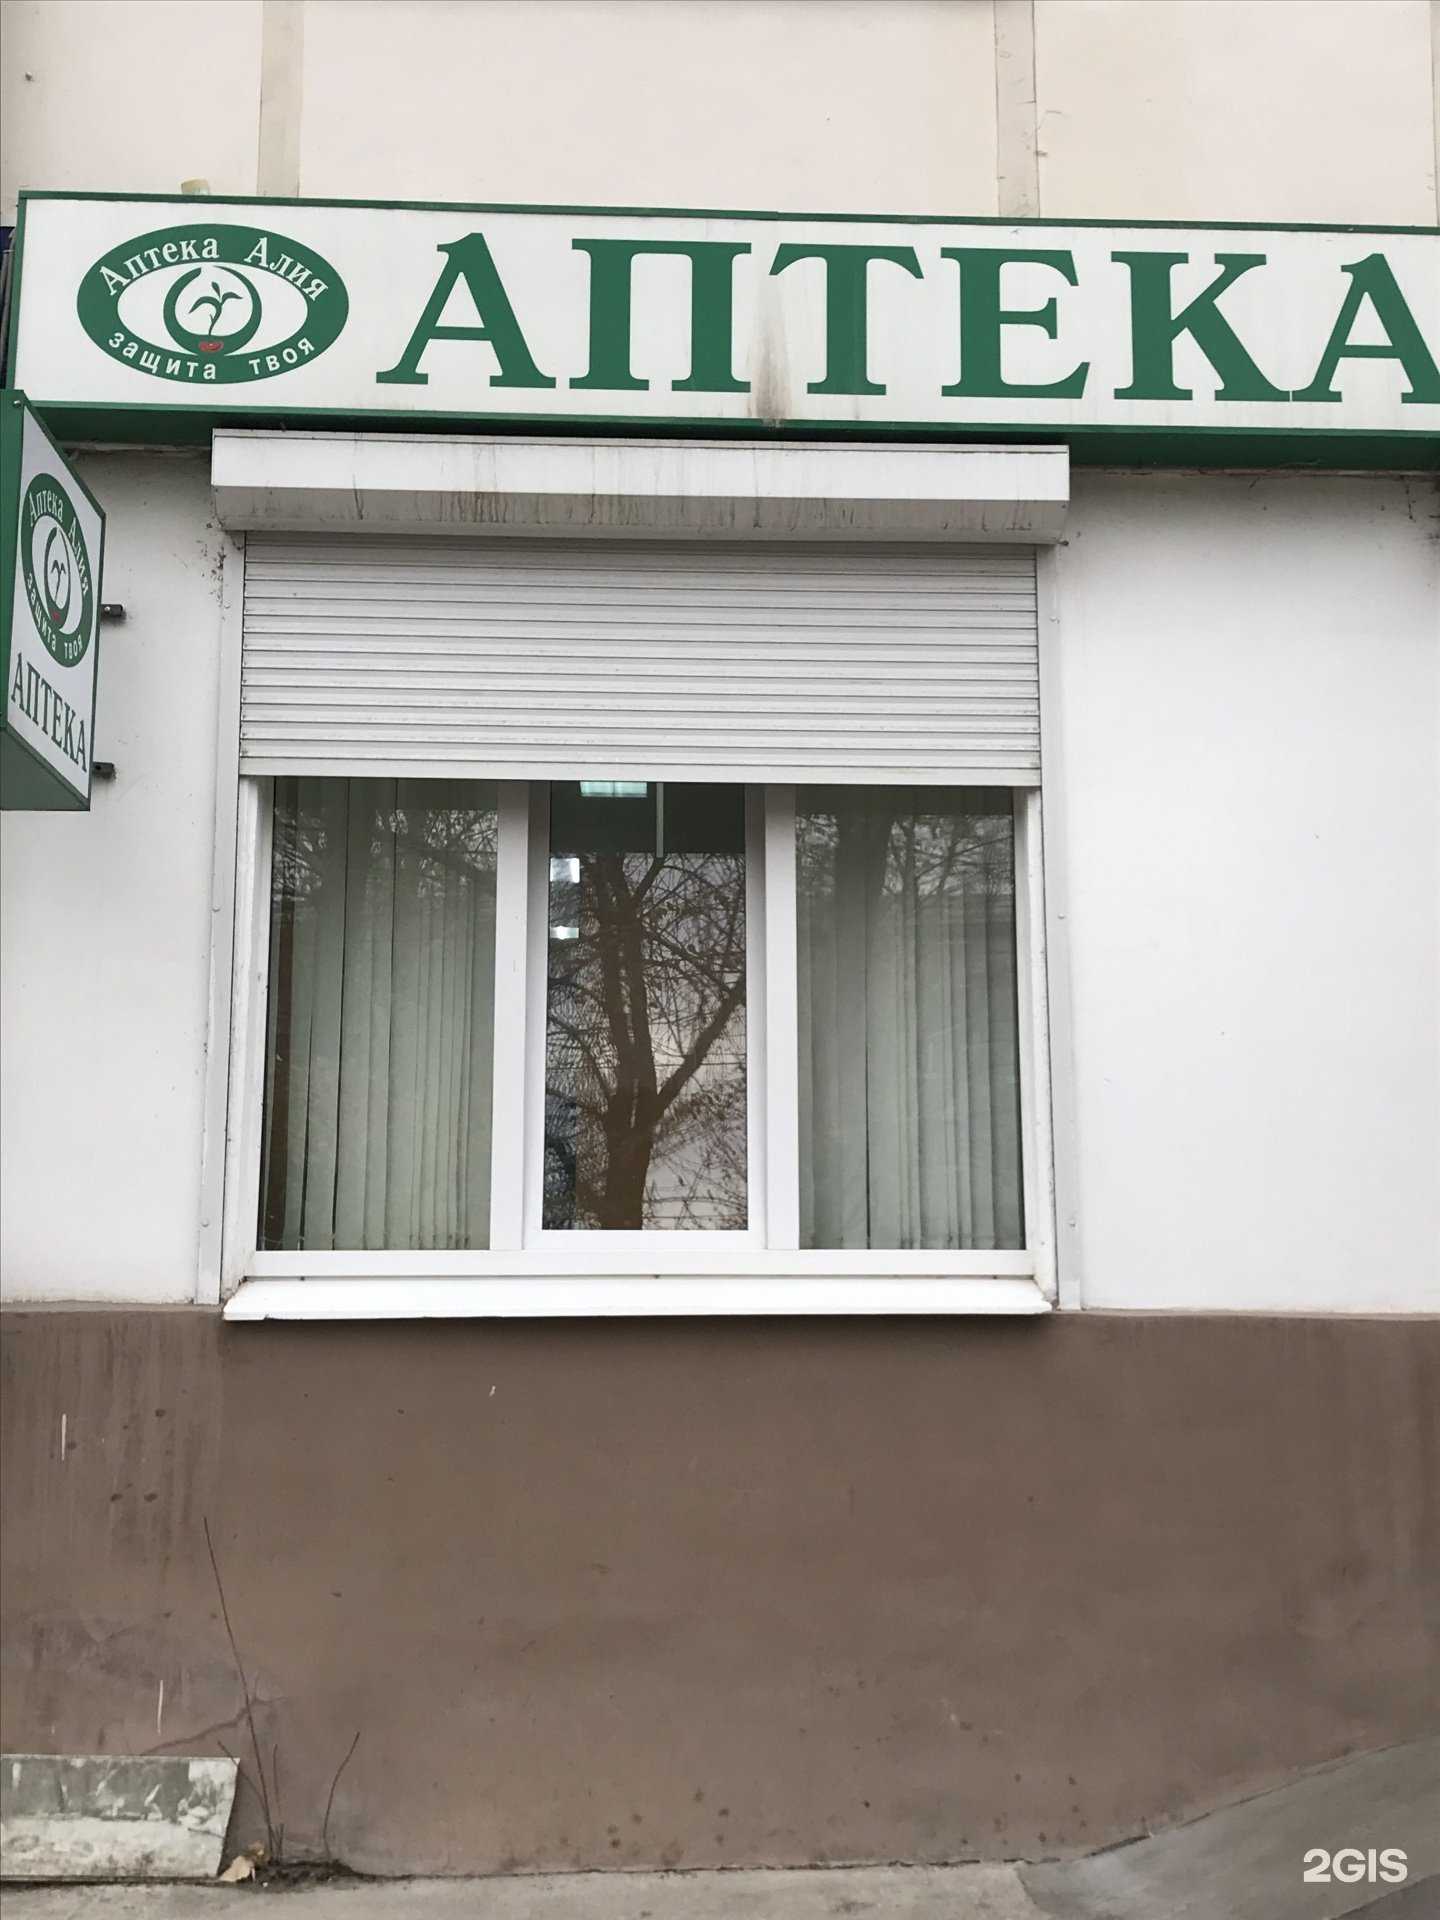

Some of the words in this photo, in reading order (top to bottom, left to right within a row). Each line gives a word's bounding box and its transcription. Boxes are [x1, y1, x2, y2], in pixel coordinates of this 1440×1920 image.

[99, 237, 220, 296] Аптека
[244, 236, 329, 301] Алия
[108, 332, 217, 380] защита
[248, 337, 315, 375] твоя
[375, 232, 1440, 405] АПТЕКА
[28, 489, 64, 528] Аптека
[67, 516, 89, 596] Алия
[26, 572, 57, 652] защита
[63, 633, 83, 660] твоя
[10, 651, 88, 773] АПТЕКА
